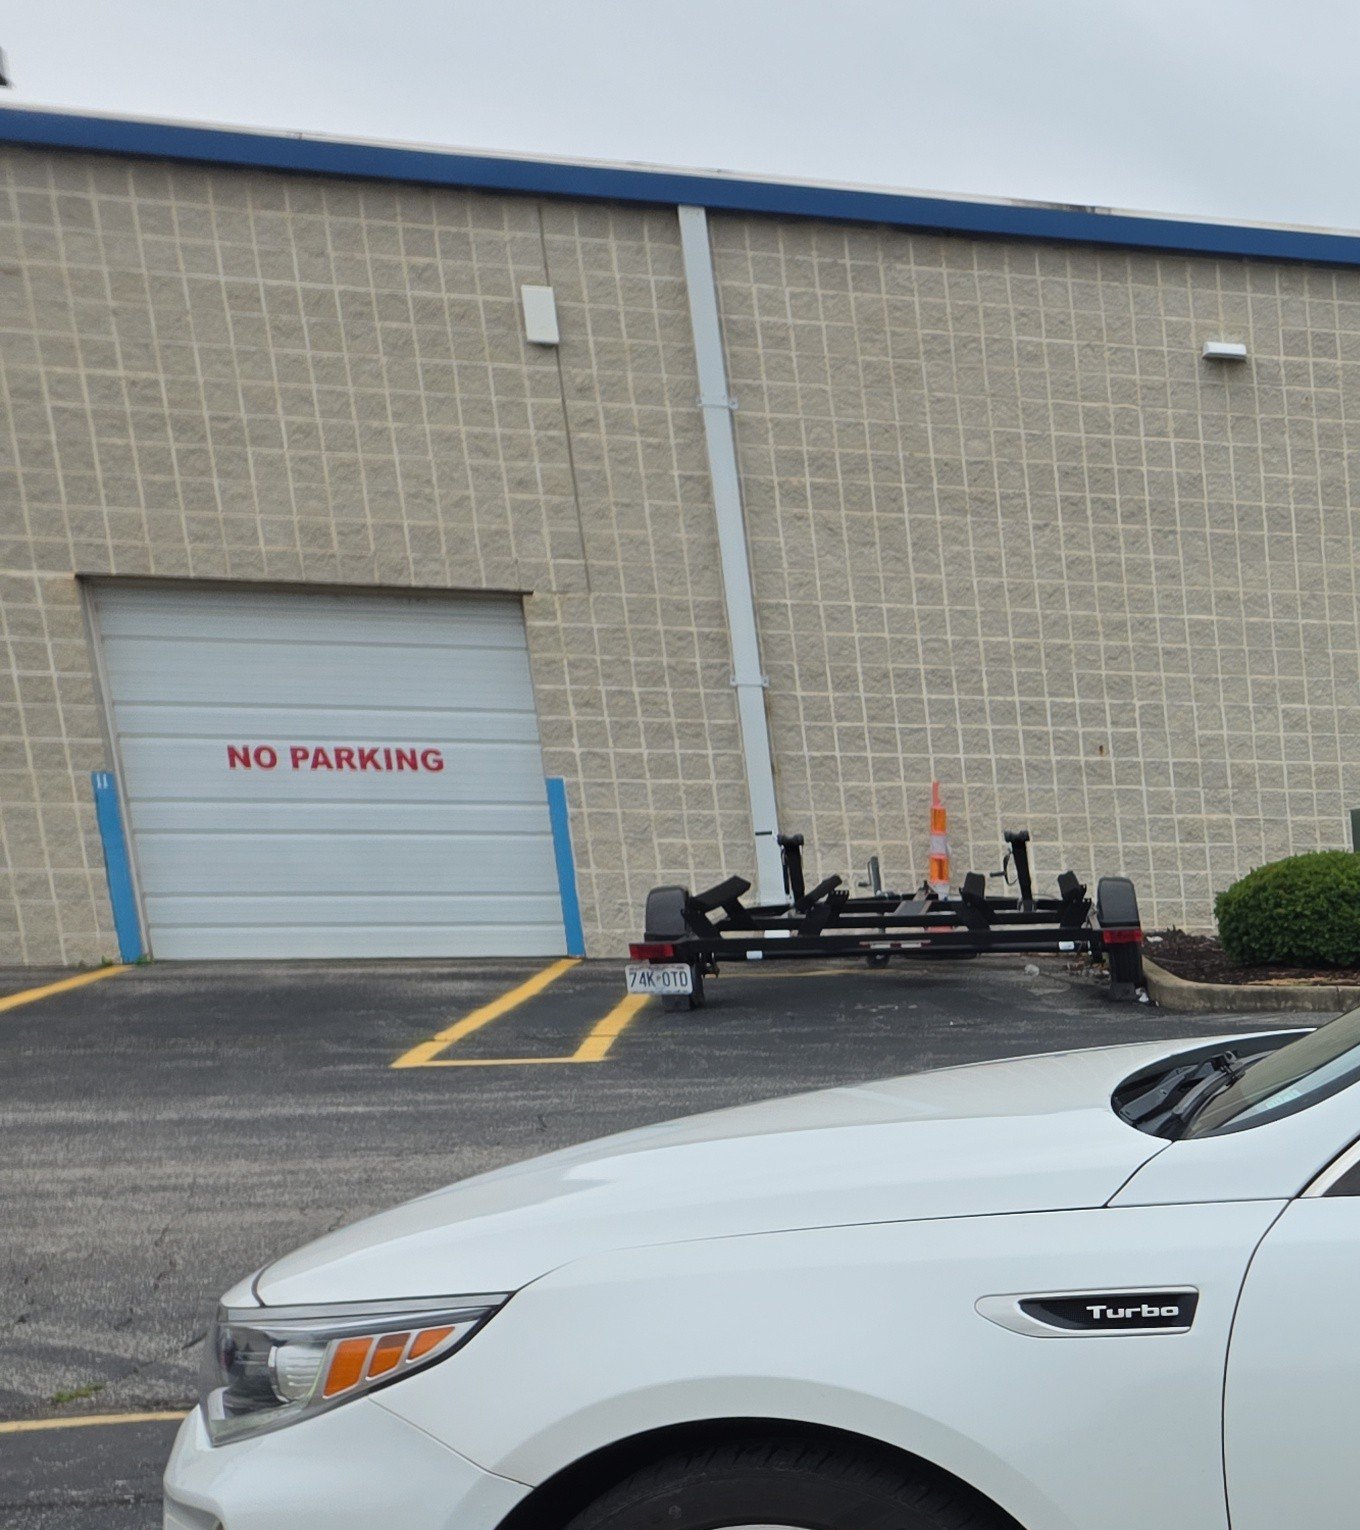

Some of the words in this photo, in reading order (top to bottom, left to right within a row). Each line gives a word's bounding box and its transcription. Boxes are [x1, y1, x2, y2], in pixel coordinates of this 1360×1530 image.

[227, 745, 277, 770] NO
[289, 745, 445, 772] PARKING
[1086, 1304, 1179, 1319] Turbo
